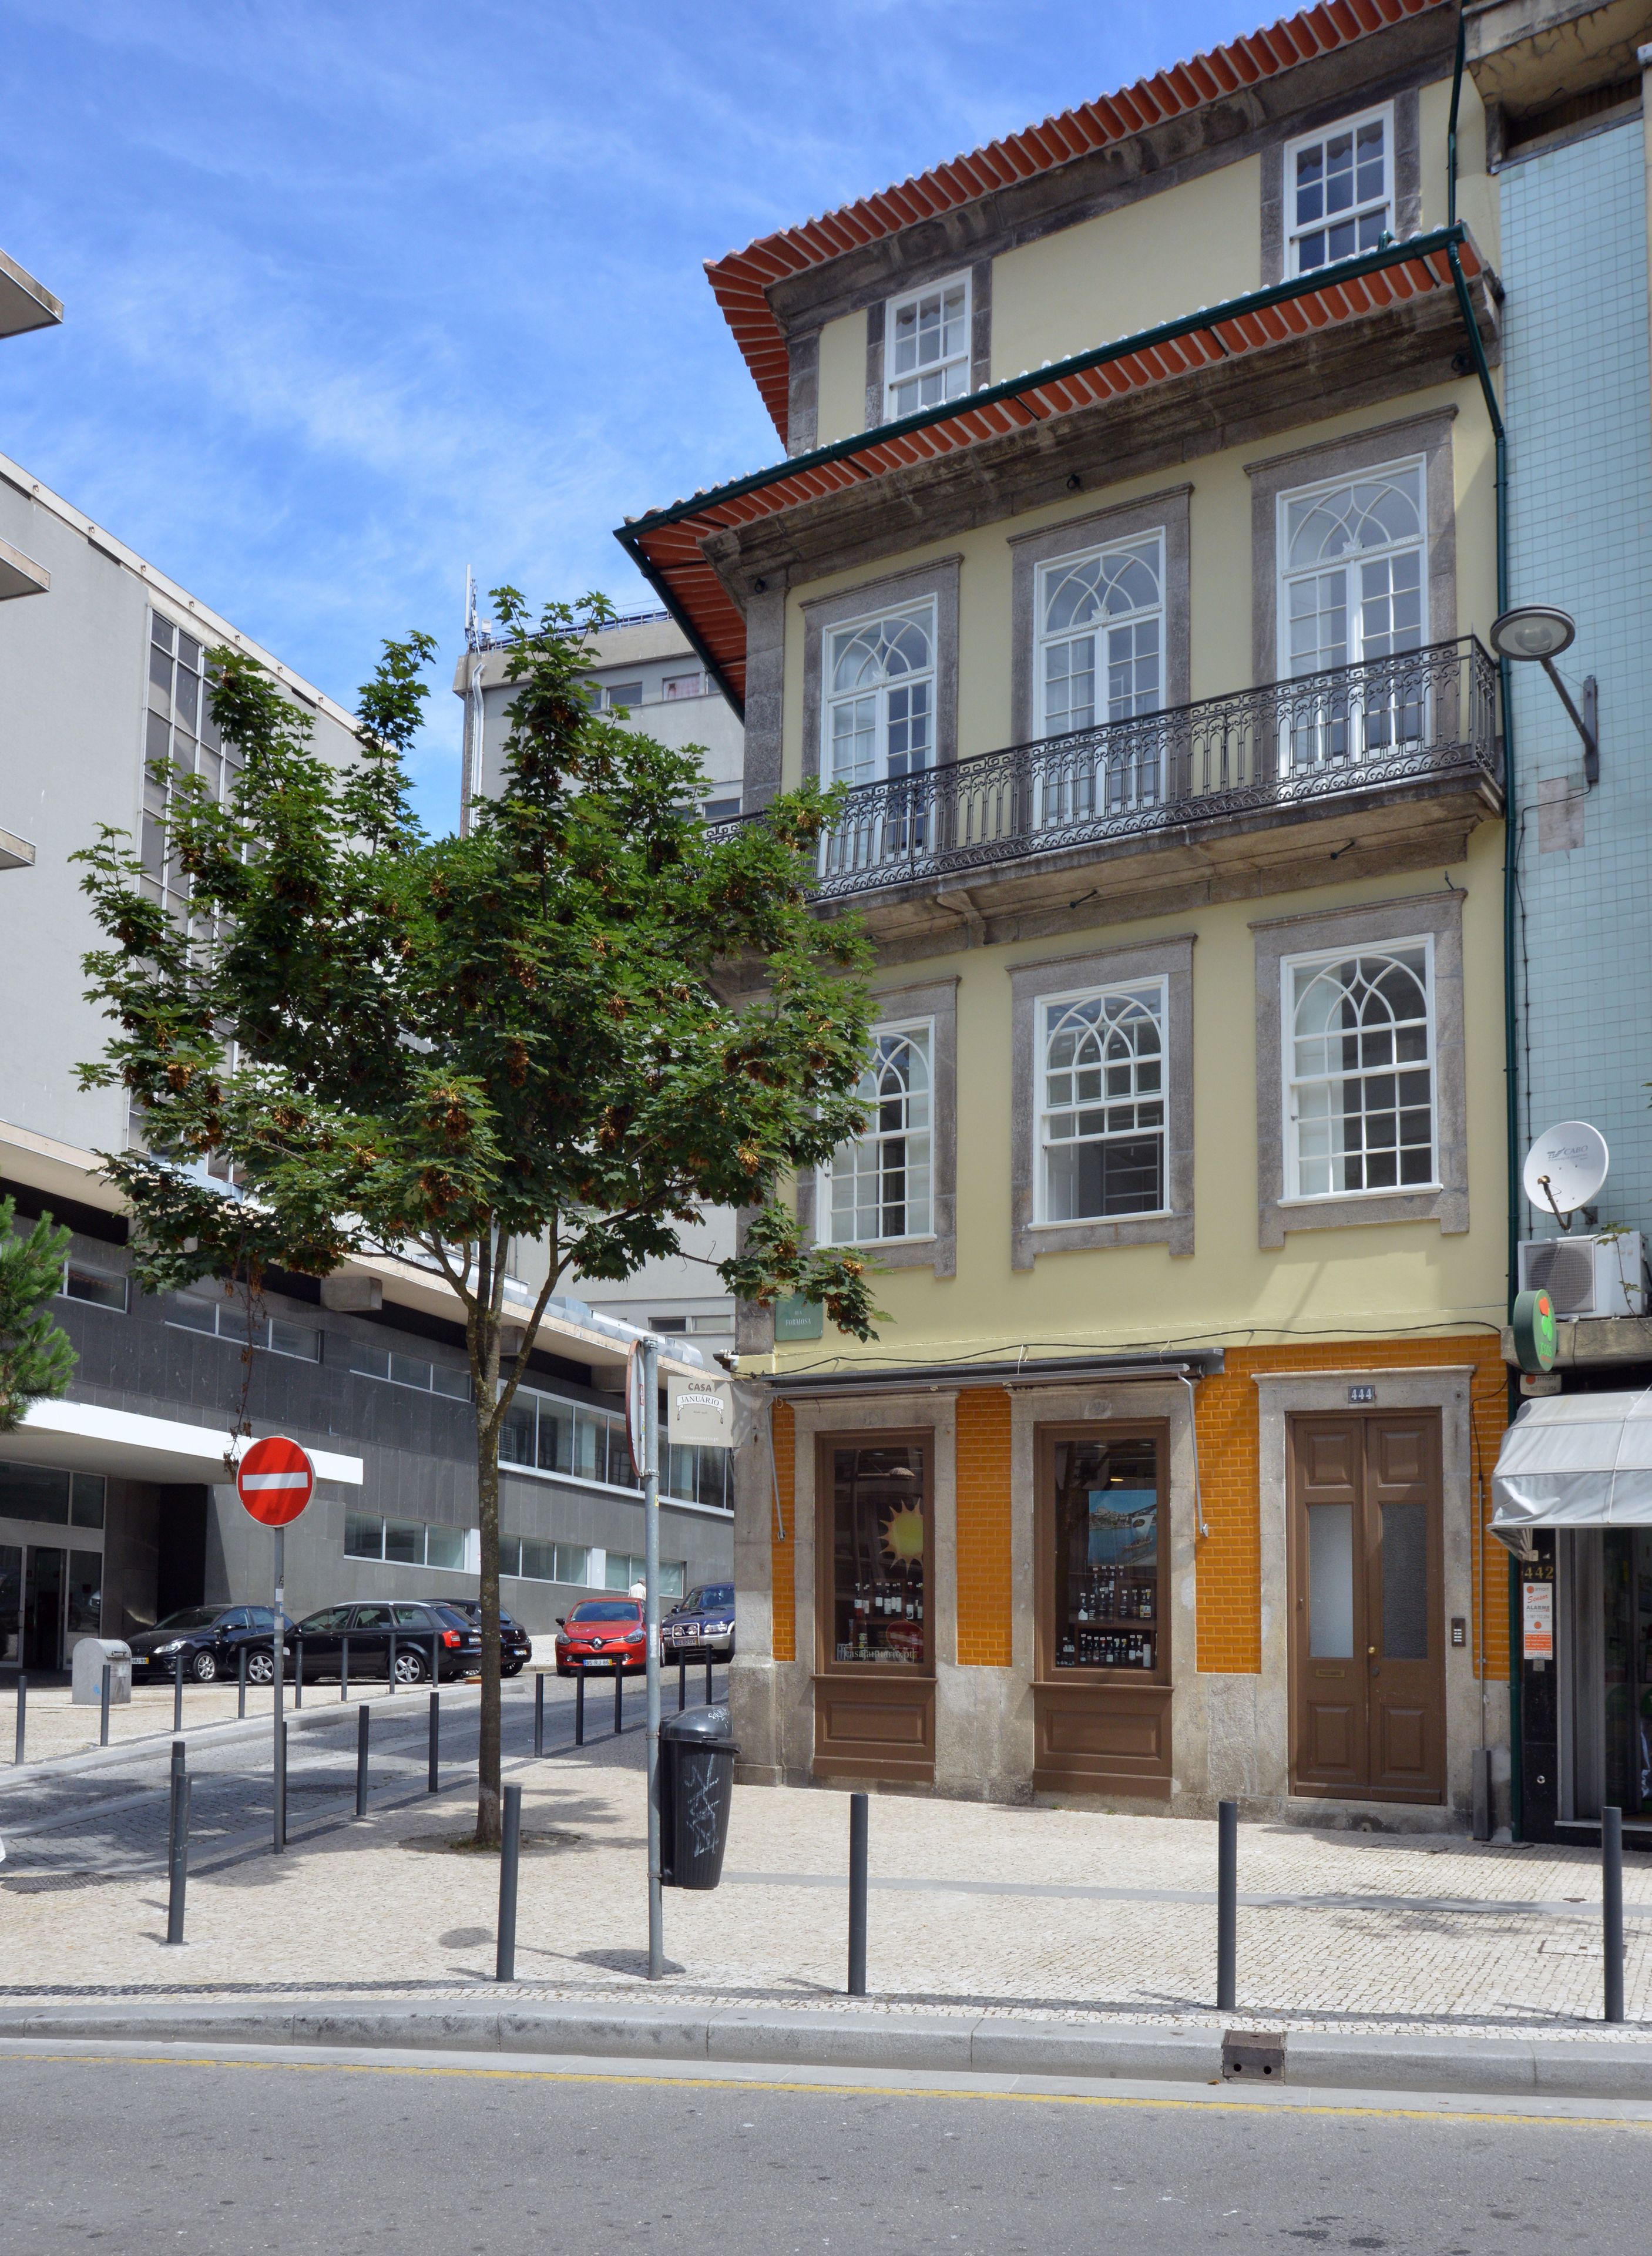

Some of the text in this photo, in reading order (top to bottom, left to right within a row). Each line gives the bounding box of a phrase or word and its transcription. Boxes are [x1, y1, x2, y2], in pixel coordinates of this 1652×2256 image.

[1564, 1145, 1588, 1156] CABO
[688, 1382, 712, 1392] CASA
[1351, 1388, 1372, 1399] 444
[681, 1395, 720, 1406] JANUÁRIO
[1525, 1566, 1554, 1579] 442
[1527, 1594, 1549, 1603] Sensor
